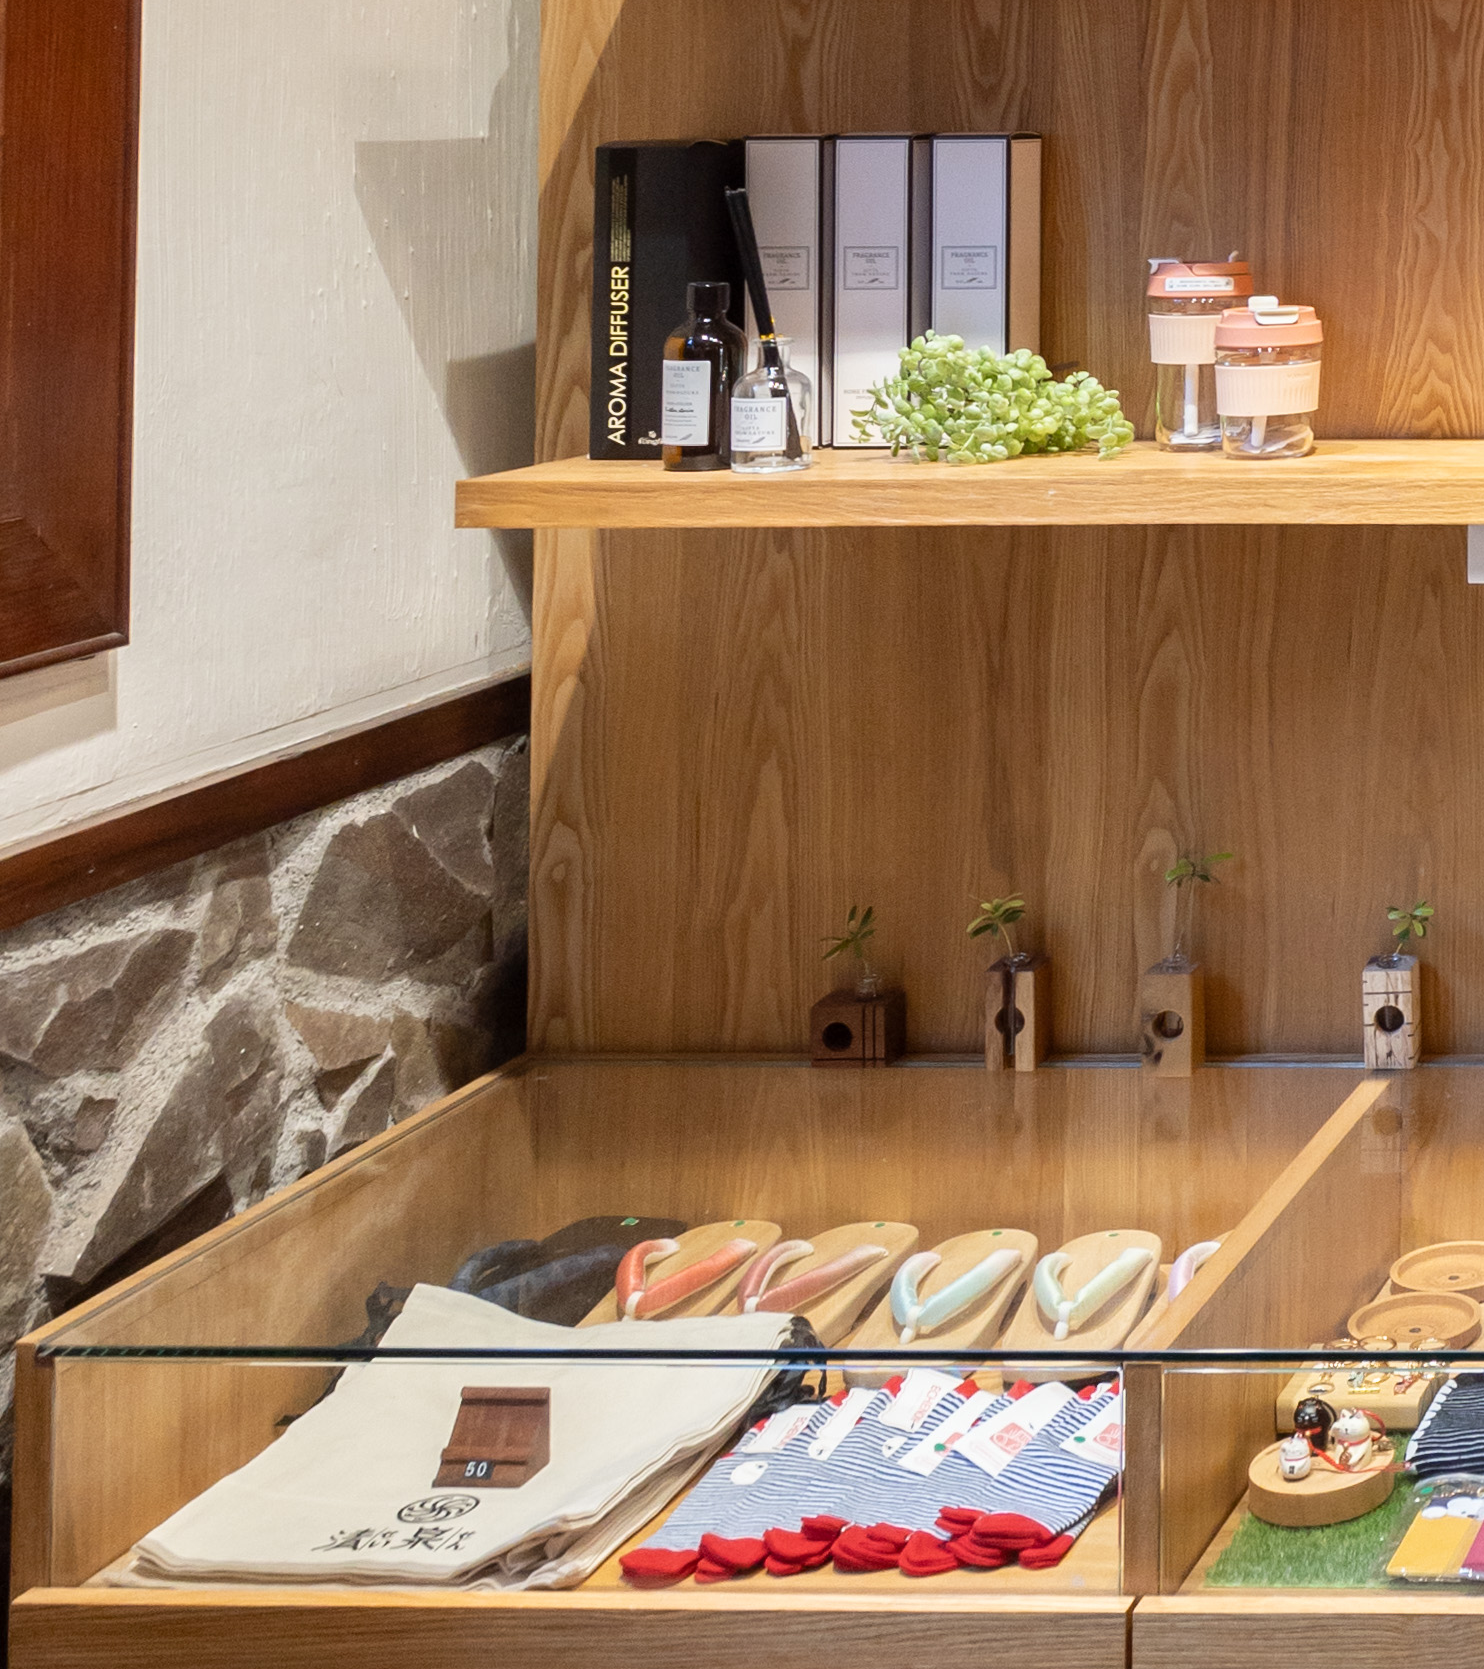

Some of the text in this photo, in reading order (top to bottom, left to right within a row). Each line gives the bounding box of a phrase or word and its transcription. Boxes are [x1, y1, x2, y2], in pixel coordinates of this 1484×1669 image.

[609, 266, 630, 357] DIFFUSER
[608, 362, 628, 445] AROMA
[465, 1461, 488, 1478] 50
